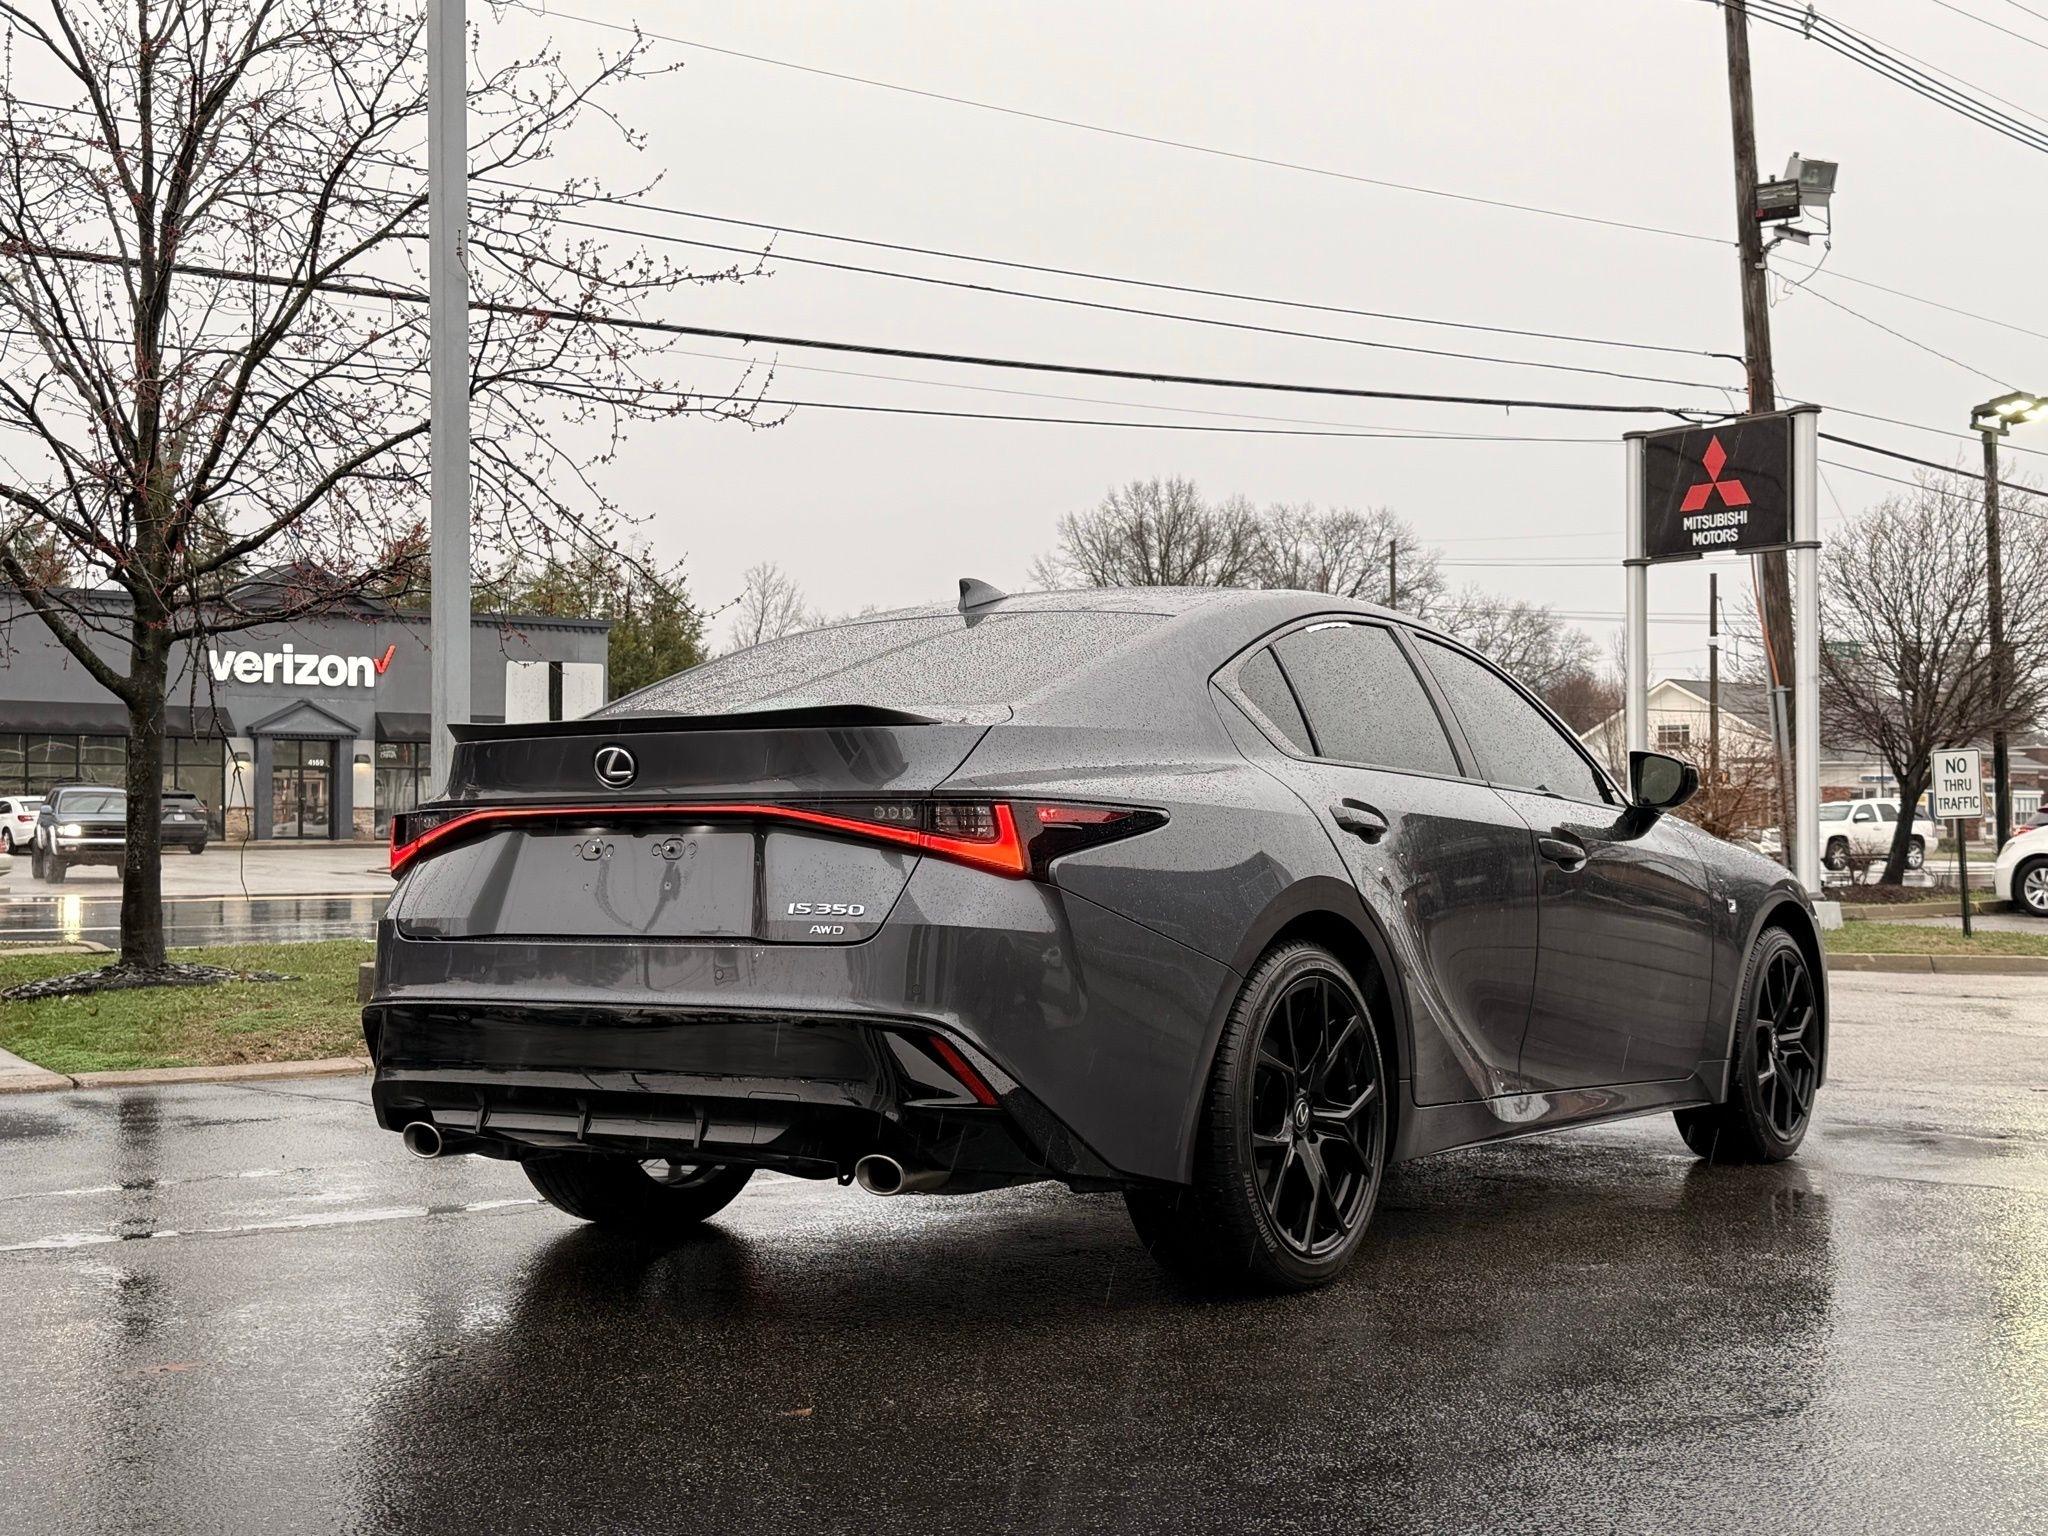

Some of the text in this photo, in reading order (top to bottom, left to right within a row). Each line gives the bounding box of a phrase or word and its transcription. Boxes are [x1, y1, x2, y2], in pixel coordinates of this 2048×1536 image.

[1683, 510, 1748, 531] MITSUBISHI
[1692, 528, 1739, 546] MOTORS
[208, 643, 375, 688] verizon
[1945, 757, 1967, 774] NO
[1943, 778, 1972, 792] THRU
[1938, 796, 1979, 810] TRAFFIC
[787, 902, 865, 917] IS 350
[809, 925, 845, 935] AWD
